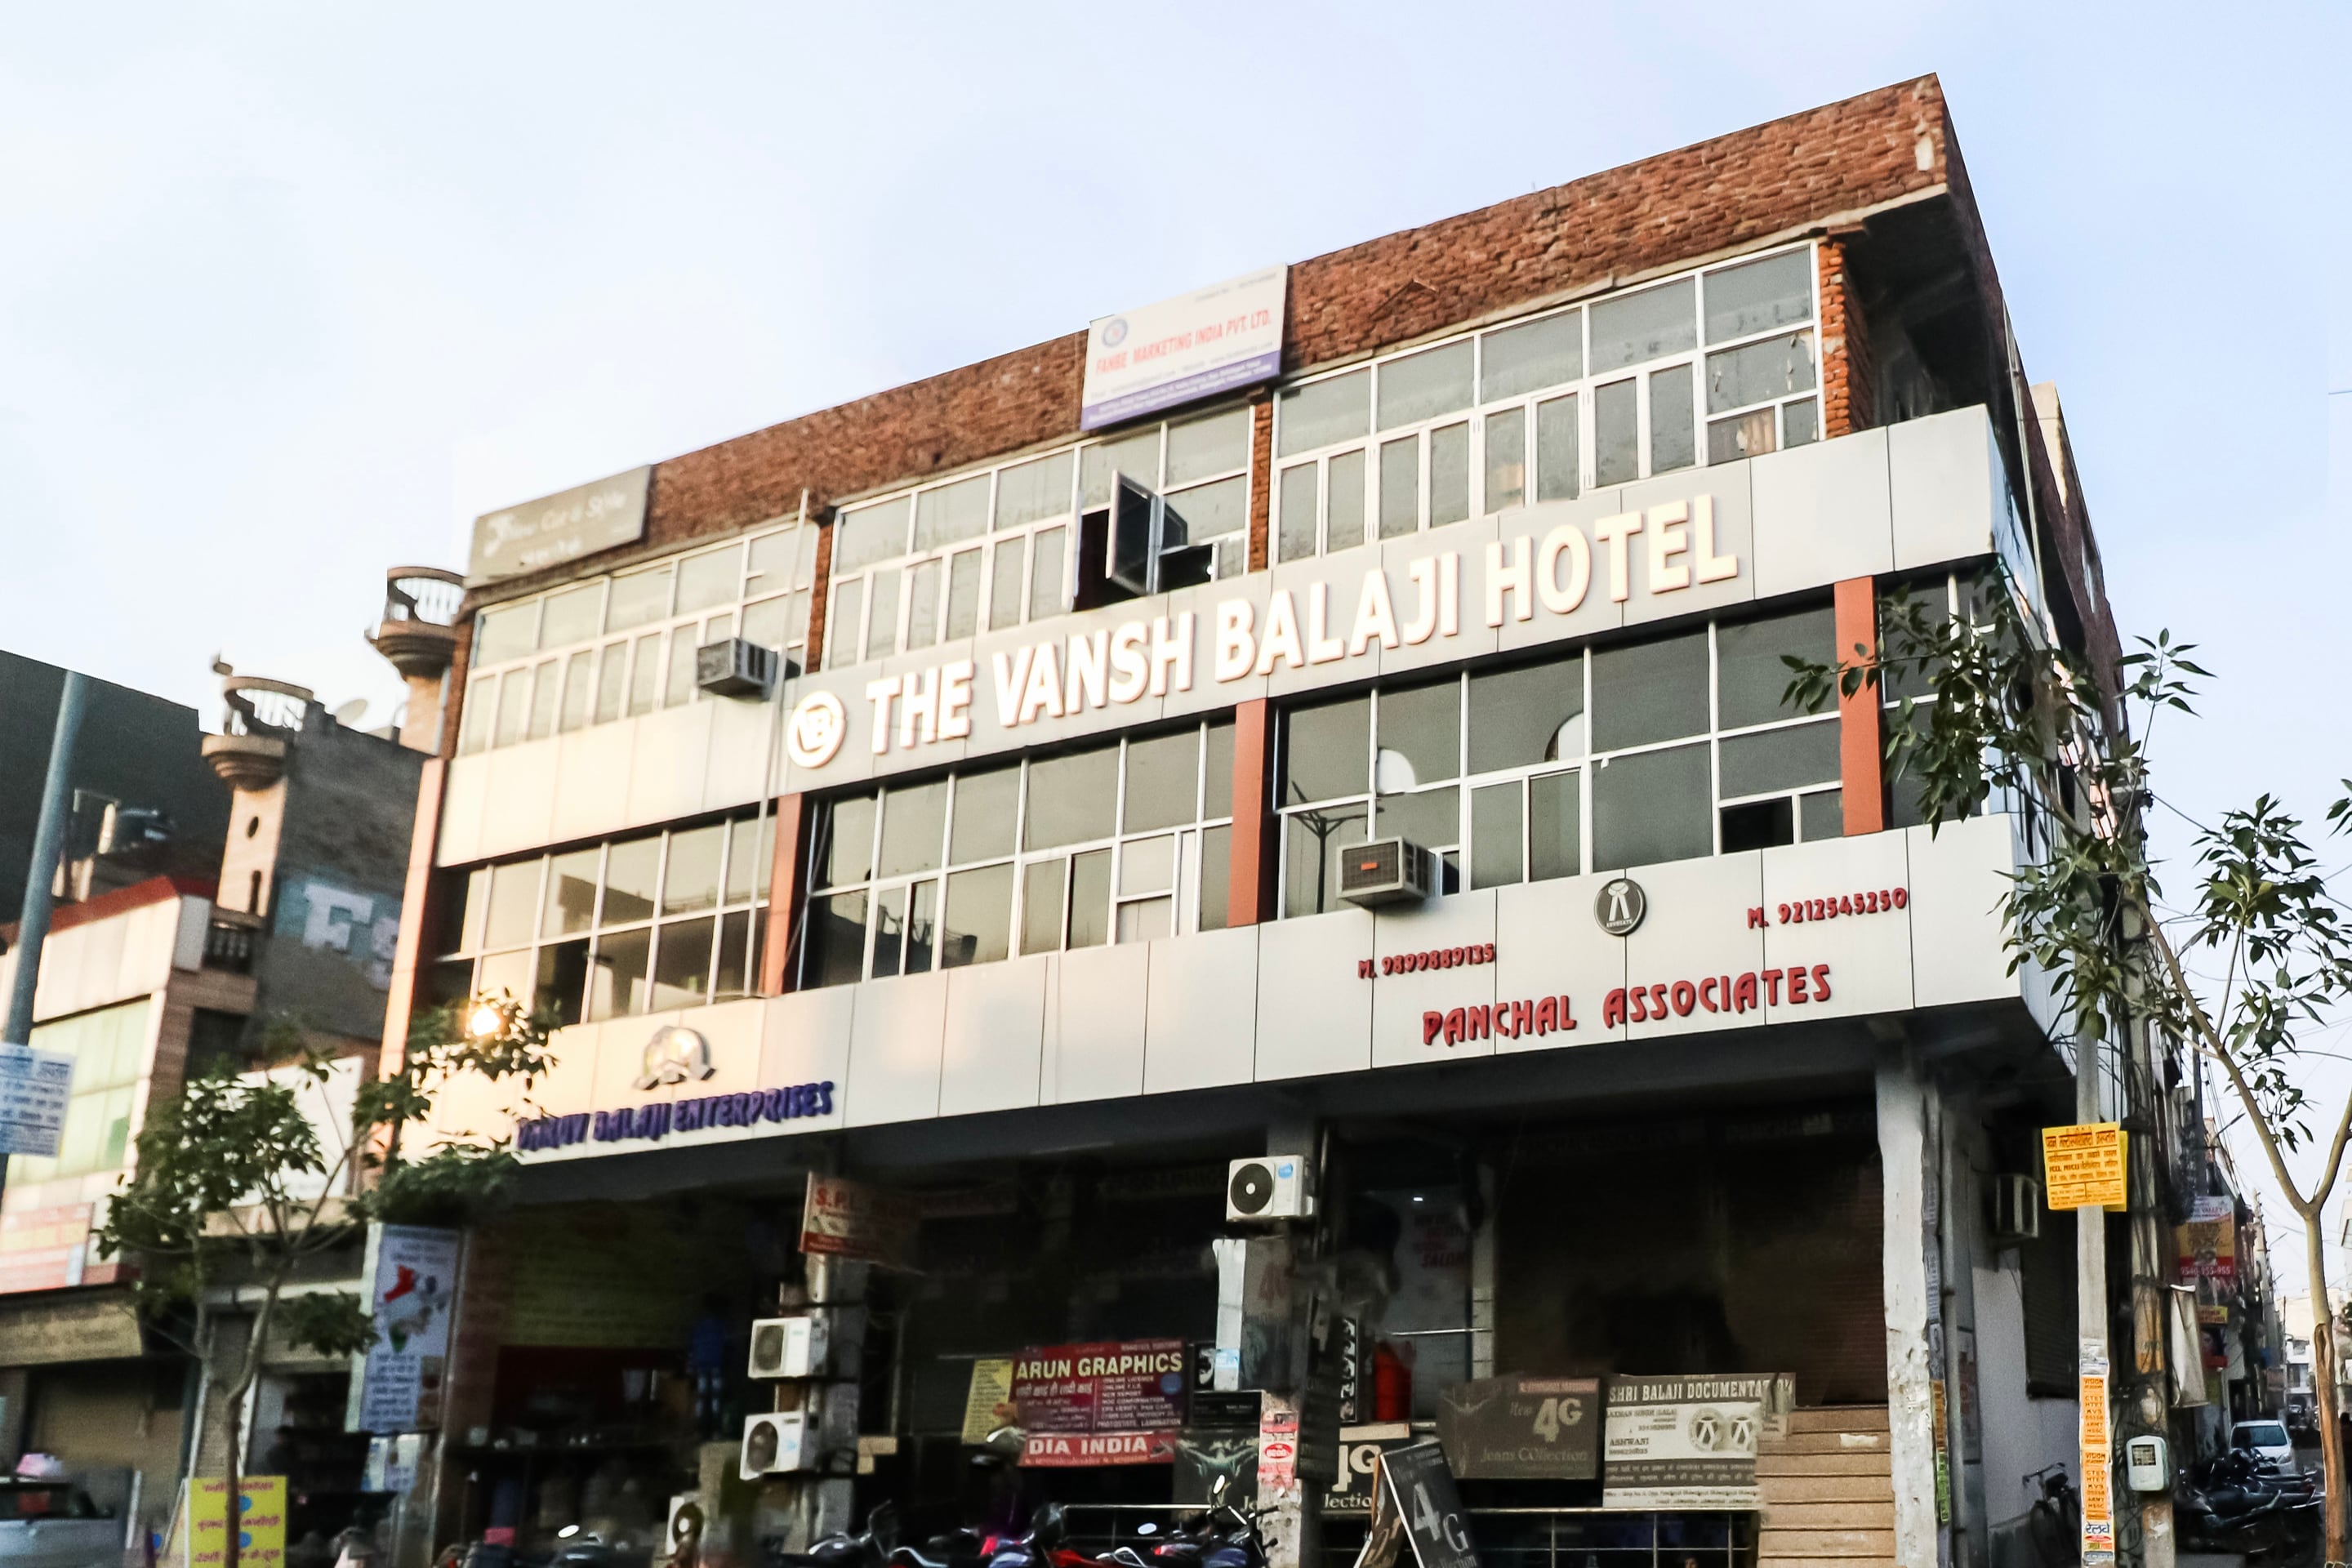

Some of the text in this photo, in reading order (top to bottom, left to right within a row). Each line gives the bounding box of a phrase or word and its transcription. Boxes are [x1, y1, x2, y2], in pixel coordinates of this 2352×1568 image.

[1133, 332, 1192, 364] MARKETING
[1195, 324, 1223, 345] INDIA
[1225, 317, 1249, 336] PVT.
[1250, 310, 1272, 331] LTD.
[866, 494, 1738, 755] THE VANSH BALAJI HOTEL
[1747, 888, 1908, 929] M. 9212545250
[1358, 943, 1494, 979] M. 9899889135
[1423, 964, 1832, 1047] PANCHAL ASSOCIATES
[672, 1081, 834, 1133] ENTERPRISES
[1016, 1352, 1183, 1379] ARUN GRAPHICS
[1610, 1384, 1637, 1402] SHRI
[1642, 1383, 1682, 1401] BALAJI
[1533, 1397, 1584, 1443] 4G
[1028, 1436, 1148, 1455] DIA INDIA
[1414, 1481, 1486, 1553] 4G
[2085, 1521, 2110, 1534] रेलवे
